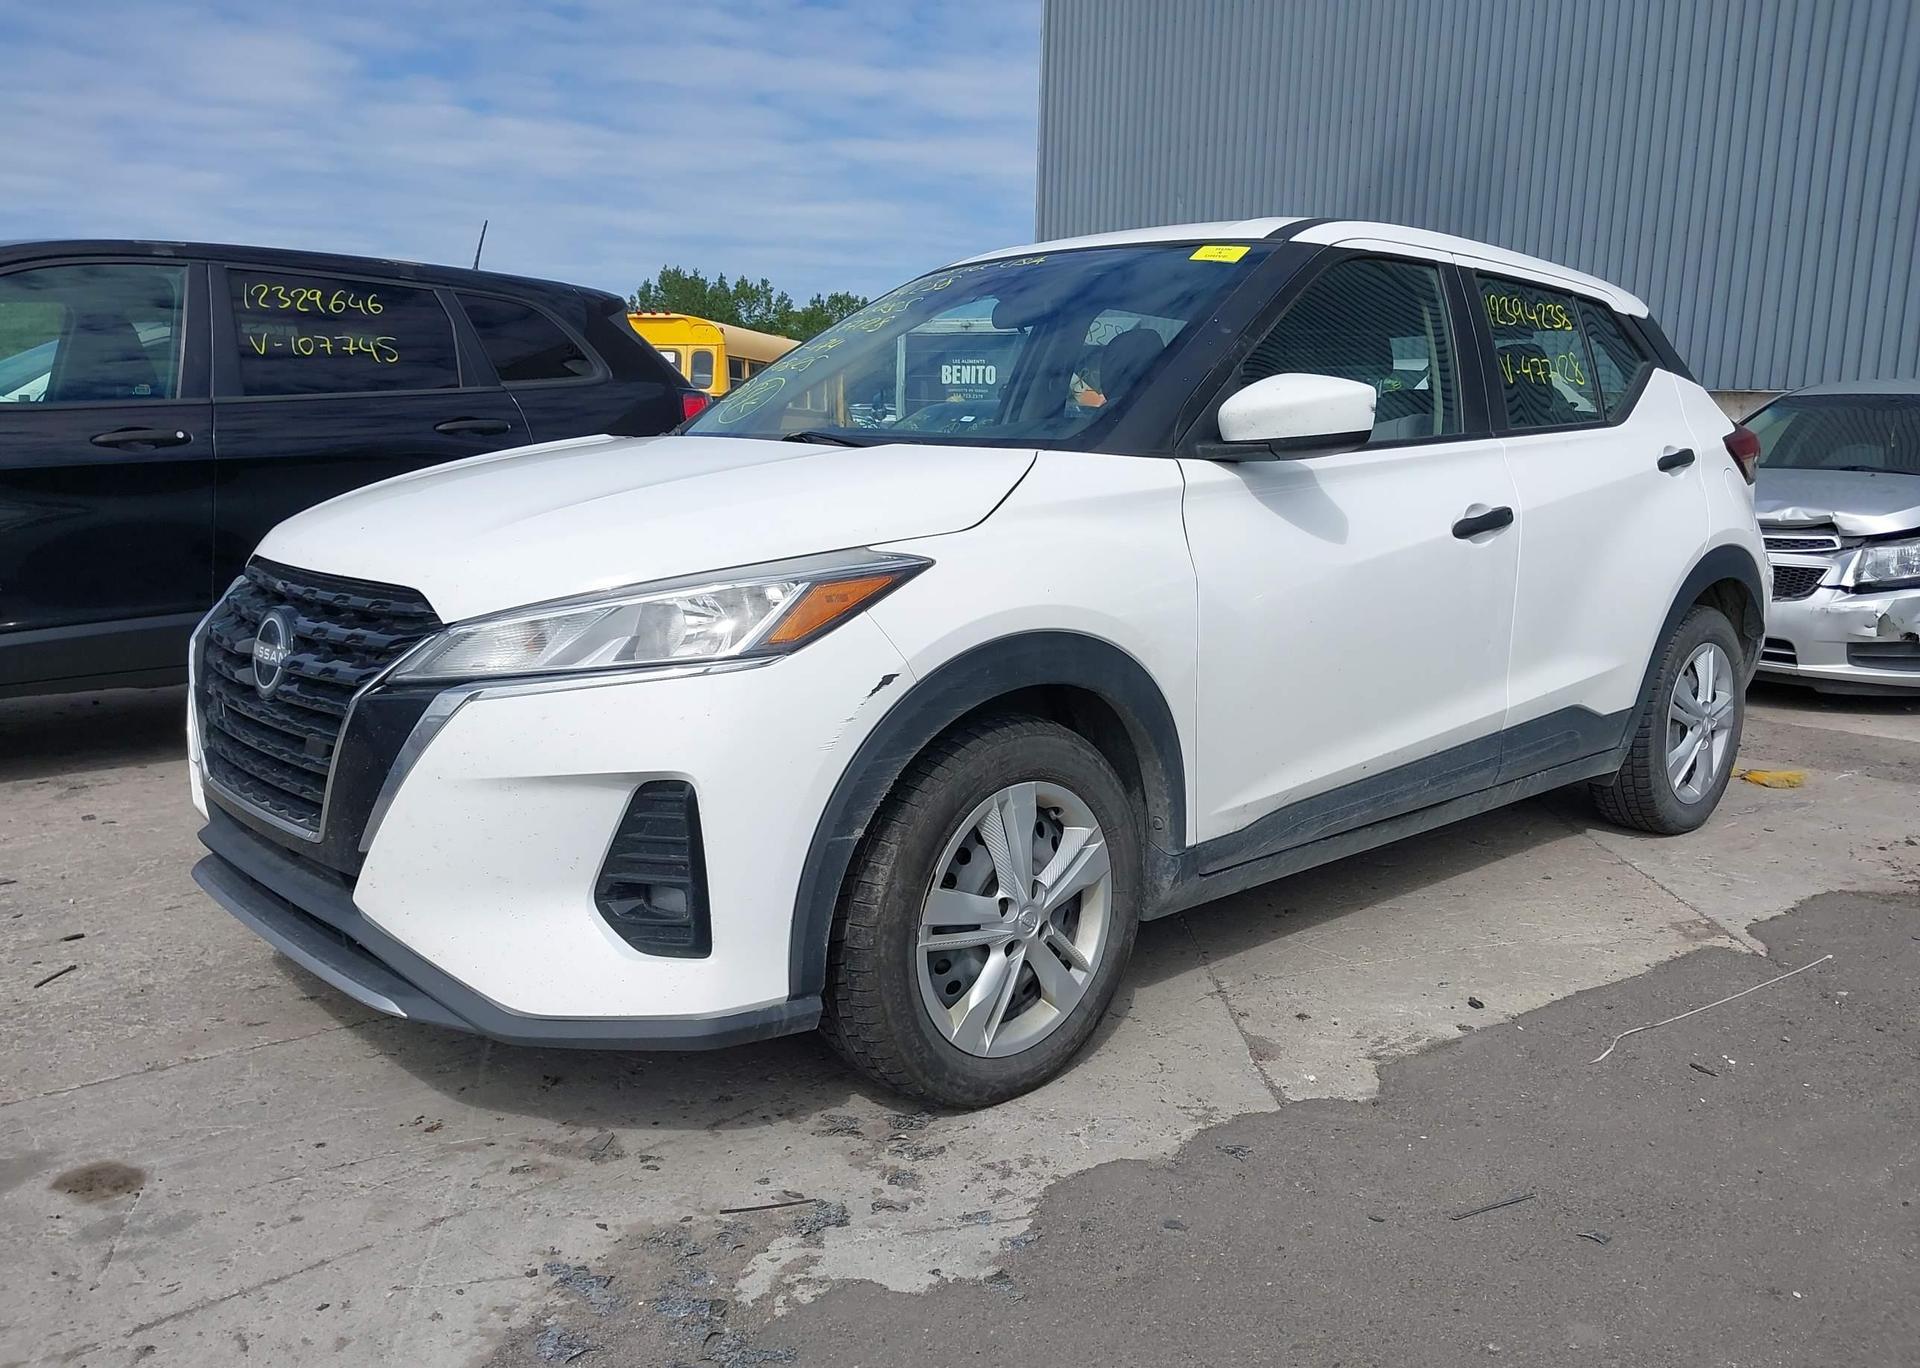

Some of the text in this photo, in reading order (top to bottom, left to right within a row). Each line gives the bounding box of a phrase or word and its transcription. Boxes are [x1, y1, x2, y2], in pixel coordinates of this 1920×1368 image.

[244, 283, 384, 315] 12329646
[1485, 294, 1573, 331] 12394238
[941, 365, 996, 385] BENITO
